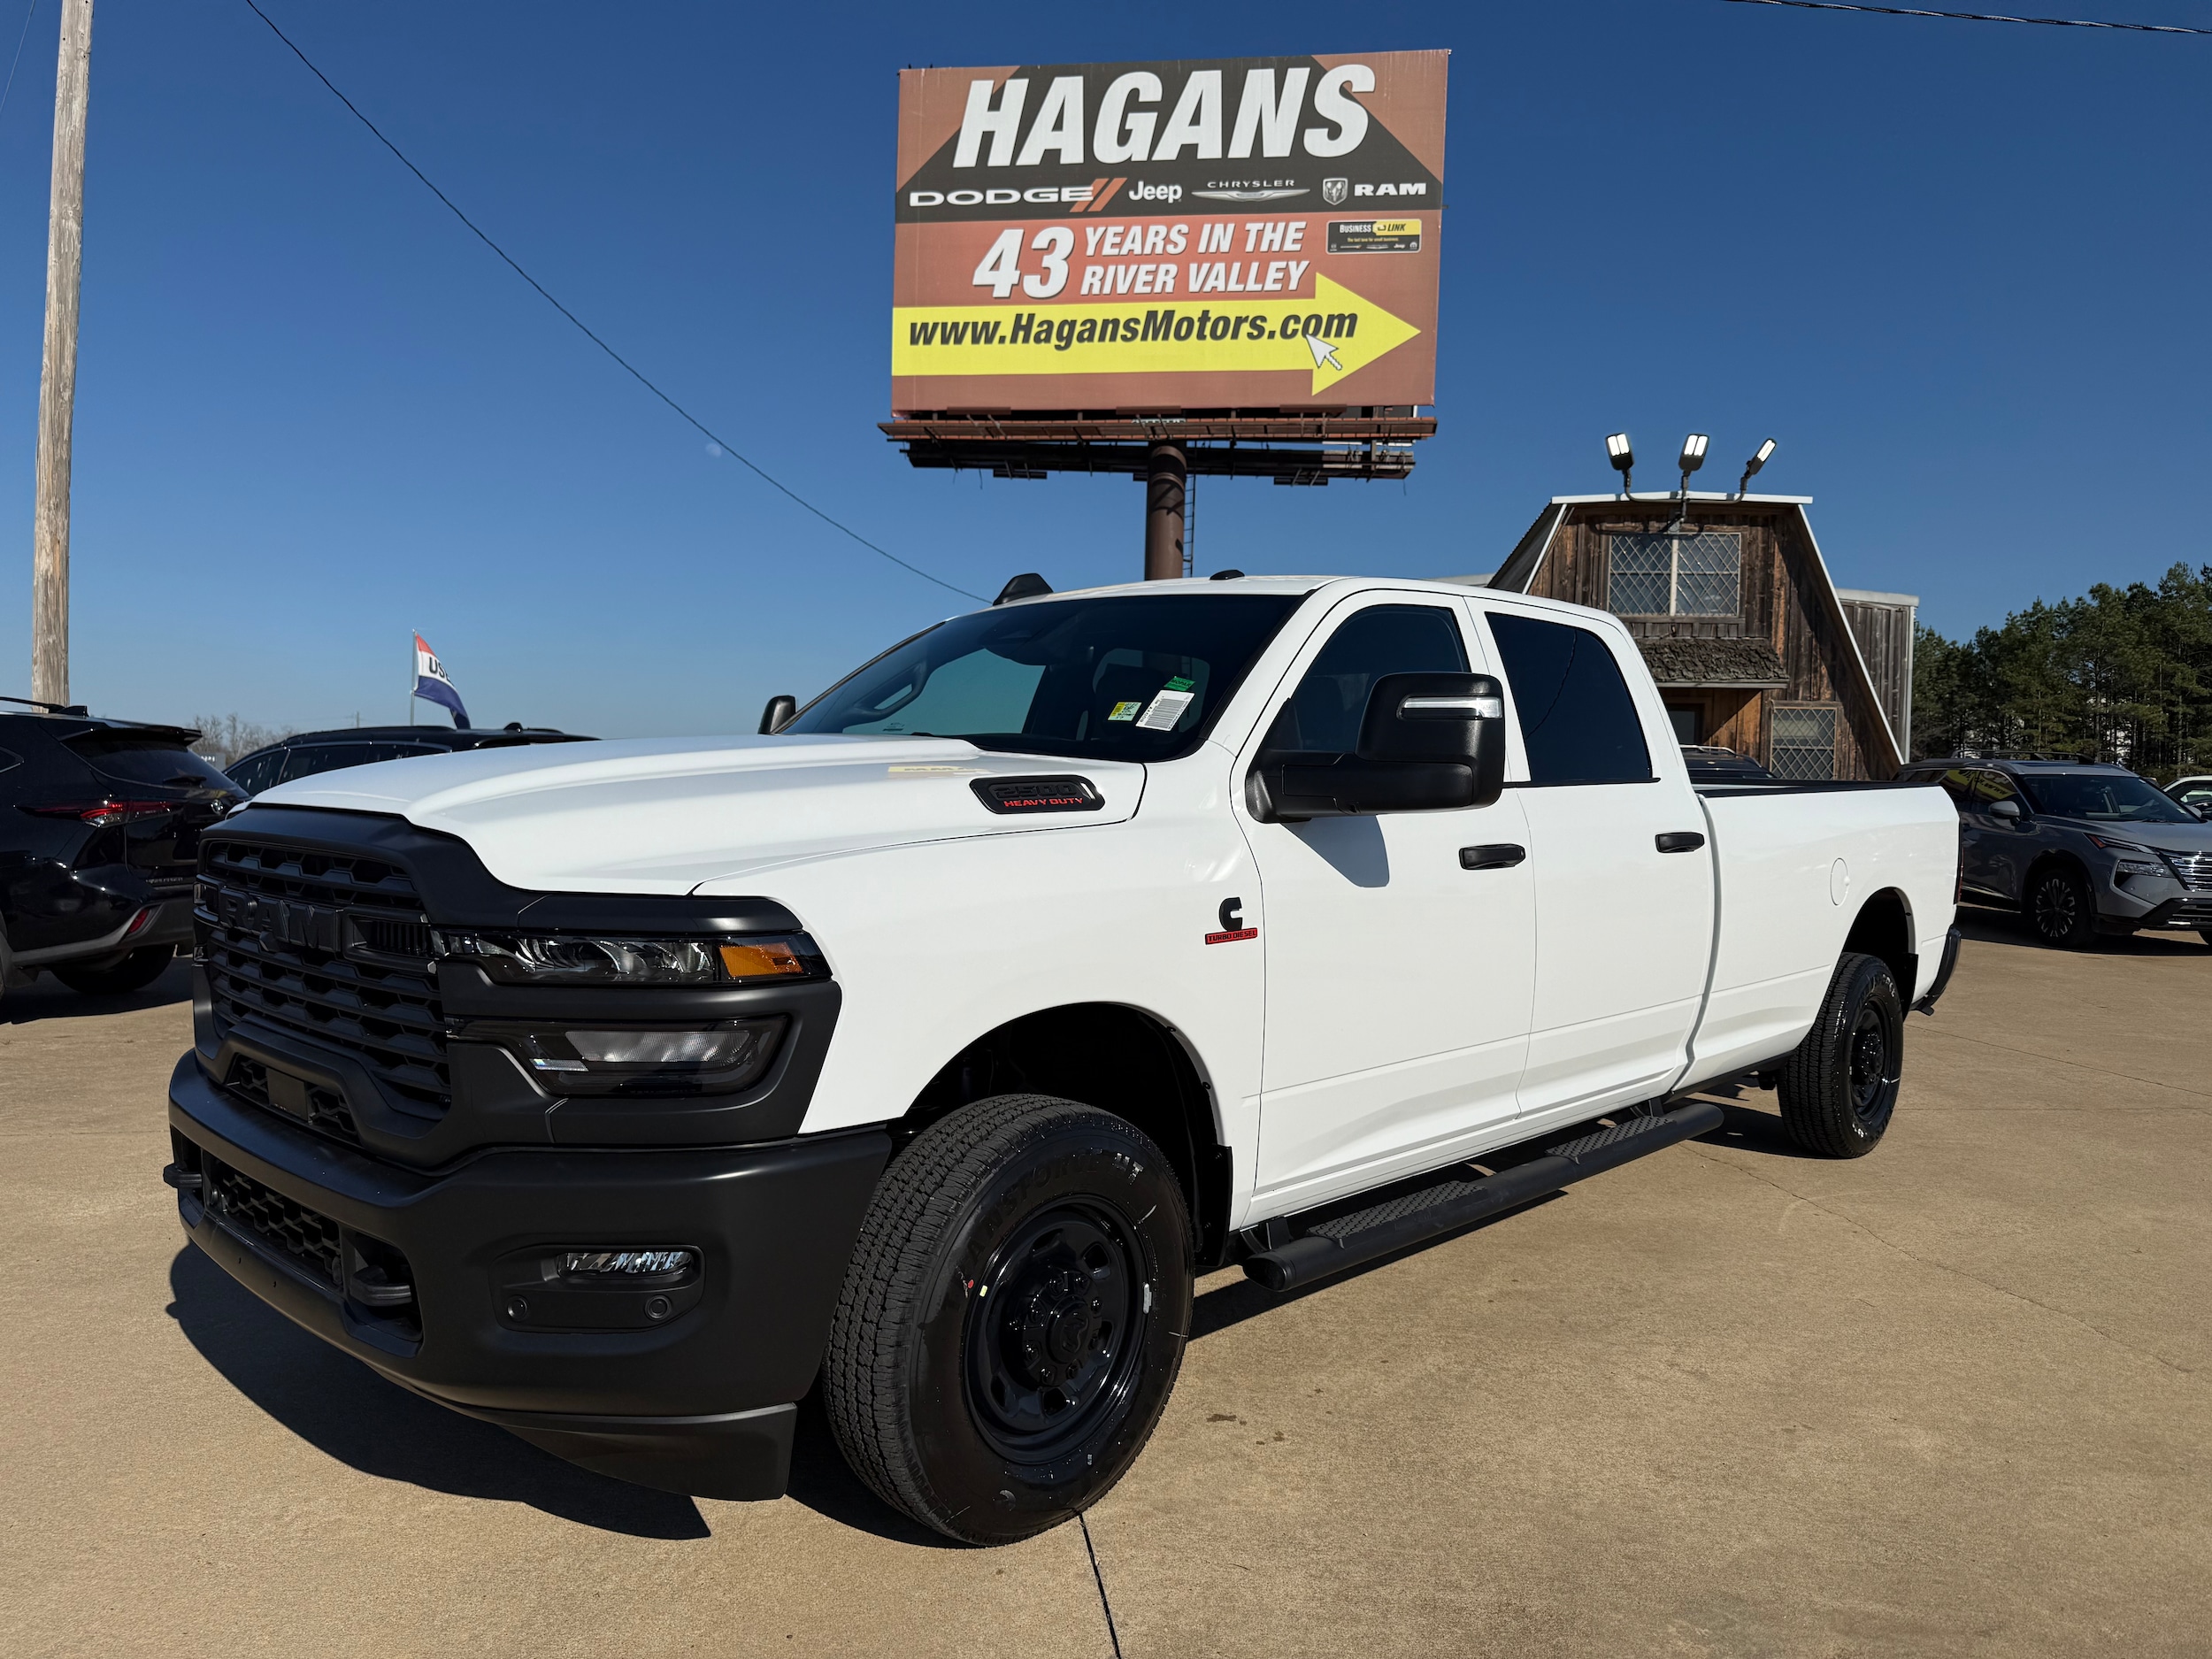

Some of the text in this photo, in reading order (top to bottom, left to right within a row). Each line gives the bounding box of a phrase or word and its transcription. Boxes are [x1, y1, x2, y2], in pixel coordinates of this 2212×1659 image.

[952, 64, 1377, 168] HAGANS
[1128, 180, 1182, 204] Jeep
[1207, 180, 1295, 188] CHRYSLER
[1354, 182, 1426, 196] RAM
[910, 186, 1094, 207] DODGE
[1085, 220, 1308, 257] YEARS IN THE
[1339, 223, 1407, 234] BUSINESS LINK
[972, 227, 1075, 298] 43
[1080, 260, 1310, 296] RIVER VALLEY
[910, 310, 1357, 351] www.HagansMotors.com
[994, 784, 1078, 798] 2500
[1004, 798, 1048, 807] HEAVY
[219, 887, 342, 953] RAM
[1233, 930, 1256, 939] DIESEL
